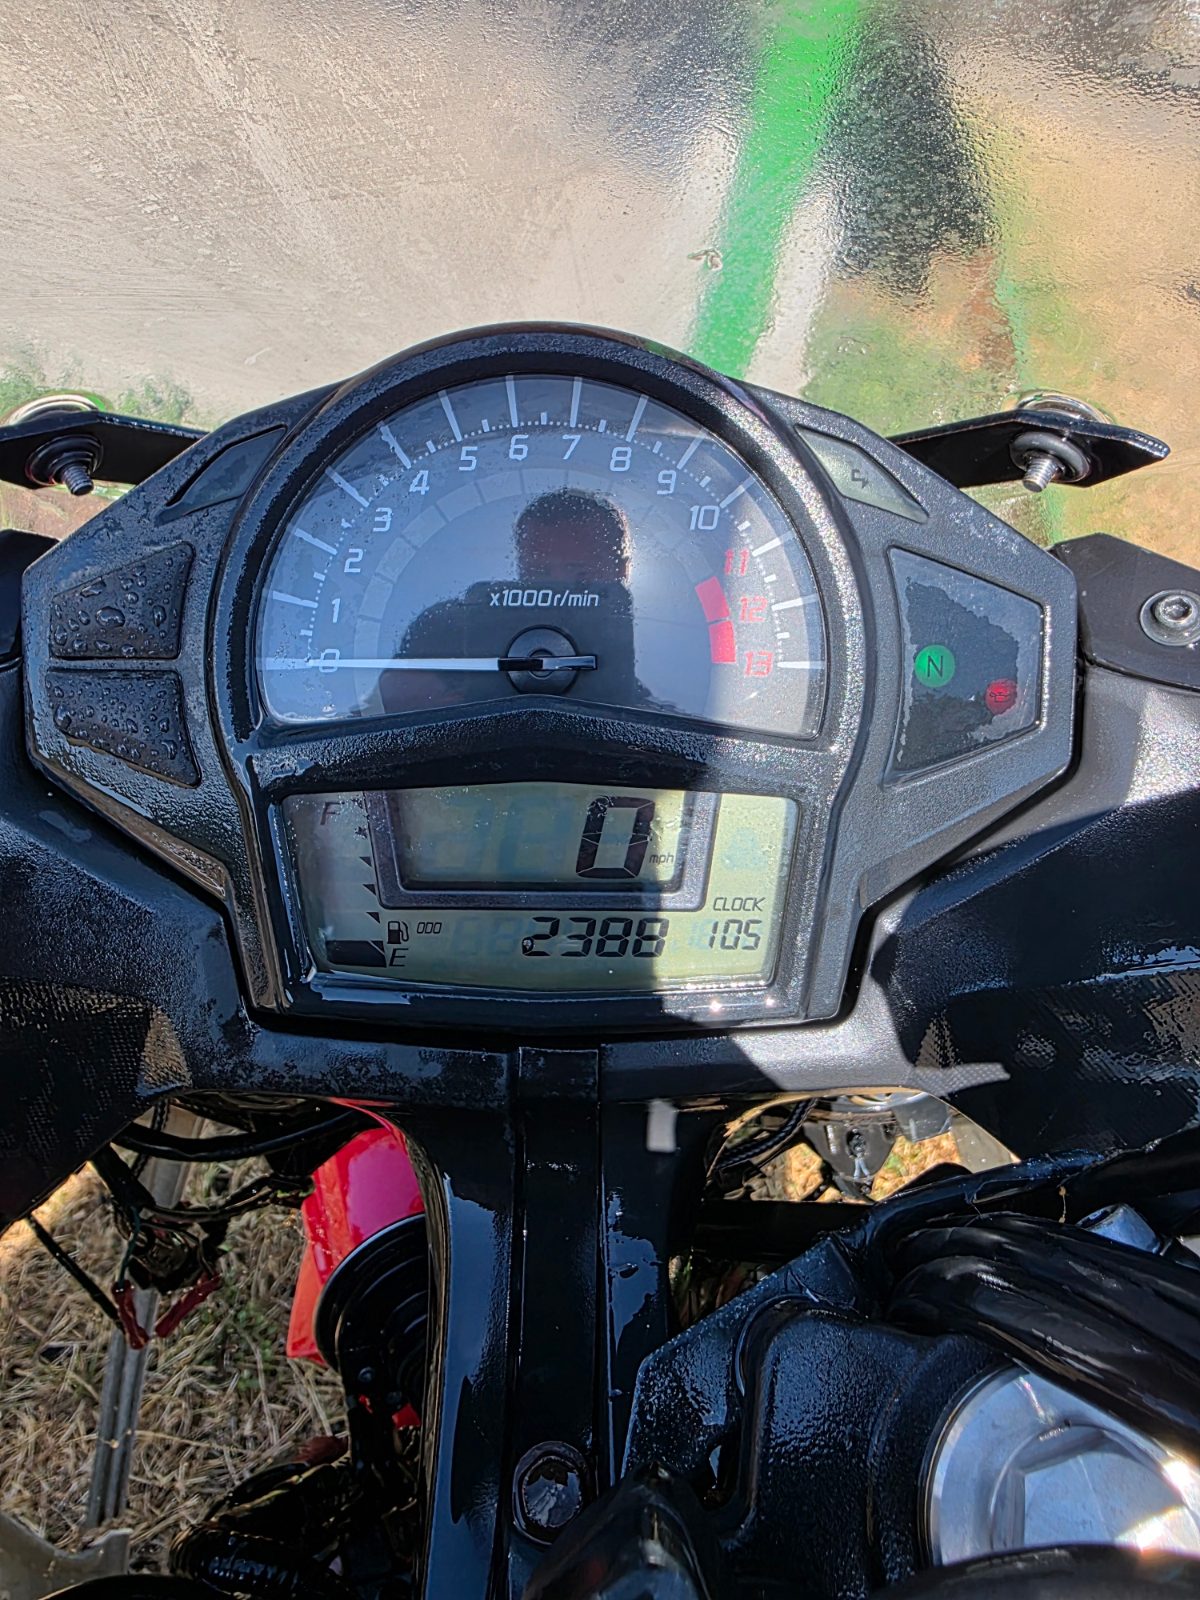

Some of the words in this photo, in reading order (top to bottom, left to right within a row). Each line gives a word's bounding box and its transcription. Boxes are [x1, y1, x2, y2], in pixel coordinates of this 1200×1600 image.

[458, 446, 478, 472] 5
[508, 434, 529, 460] 6
[561, 434, 581, 460] 7
[609, 446, 632, 472] 8
[409, 469, 430, 495] 4
[656, 469, 677, 495] 9
[372, 506, 393, 532] 3
[689, 504, 720, 531] 10
[343, 548, 364, 573] 2
[331, 597, 341, 623] 1
[738, 595, 768, 623] 12
[743, 650, 774, 677] 13
[926, 655, 944, 678] N
[576, 796, 655, 879] 0
[648, 853, 675, 866] mph
[713, 896, 766, 912] CLOCK
[521, 916, 670, 958] 2388
[708, 918, 763, 951] 105
[389, 947, 410, 967] E
